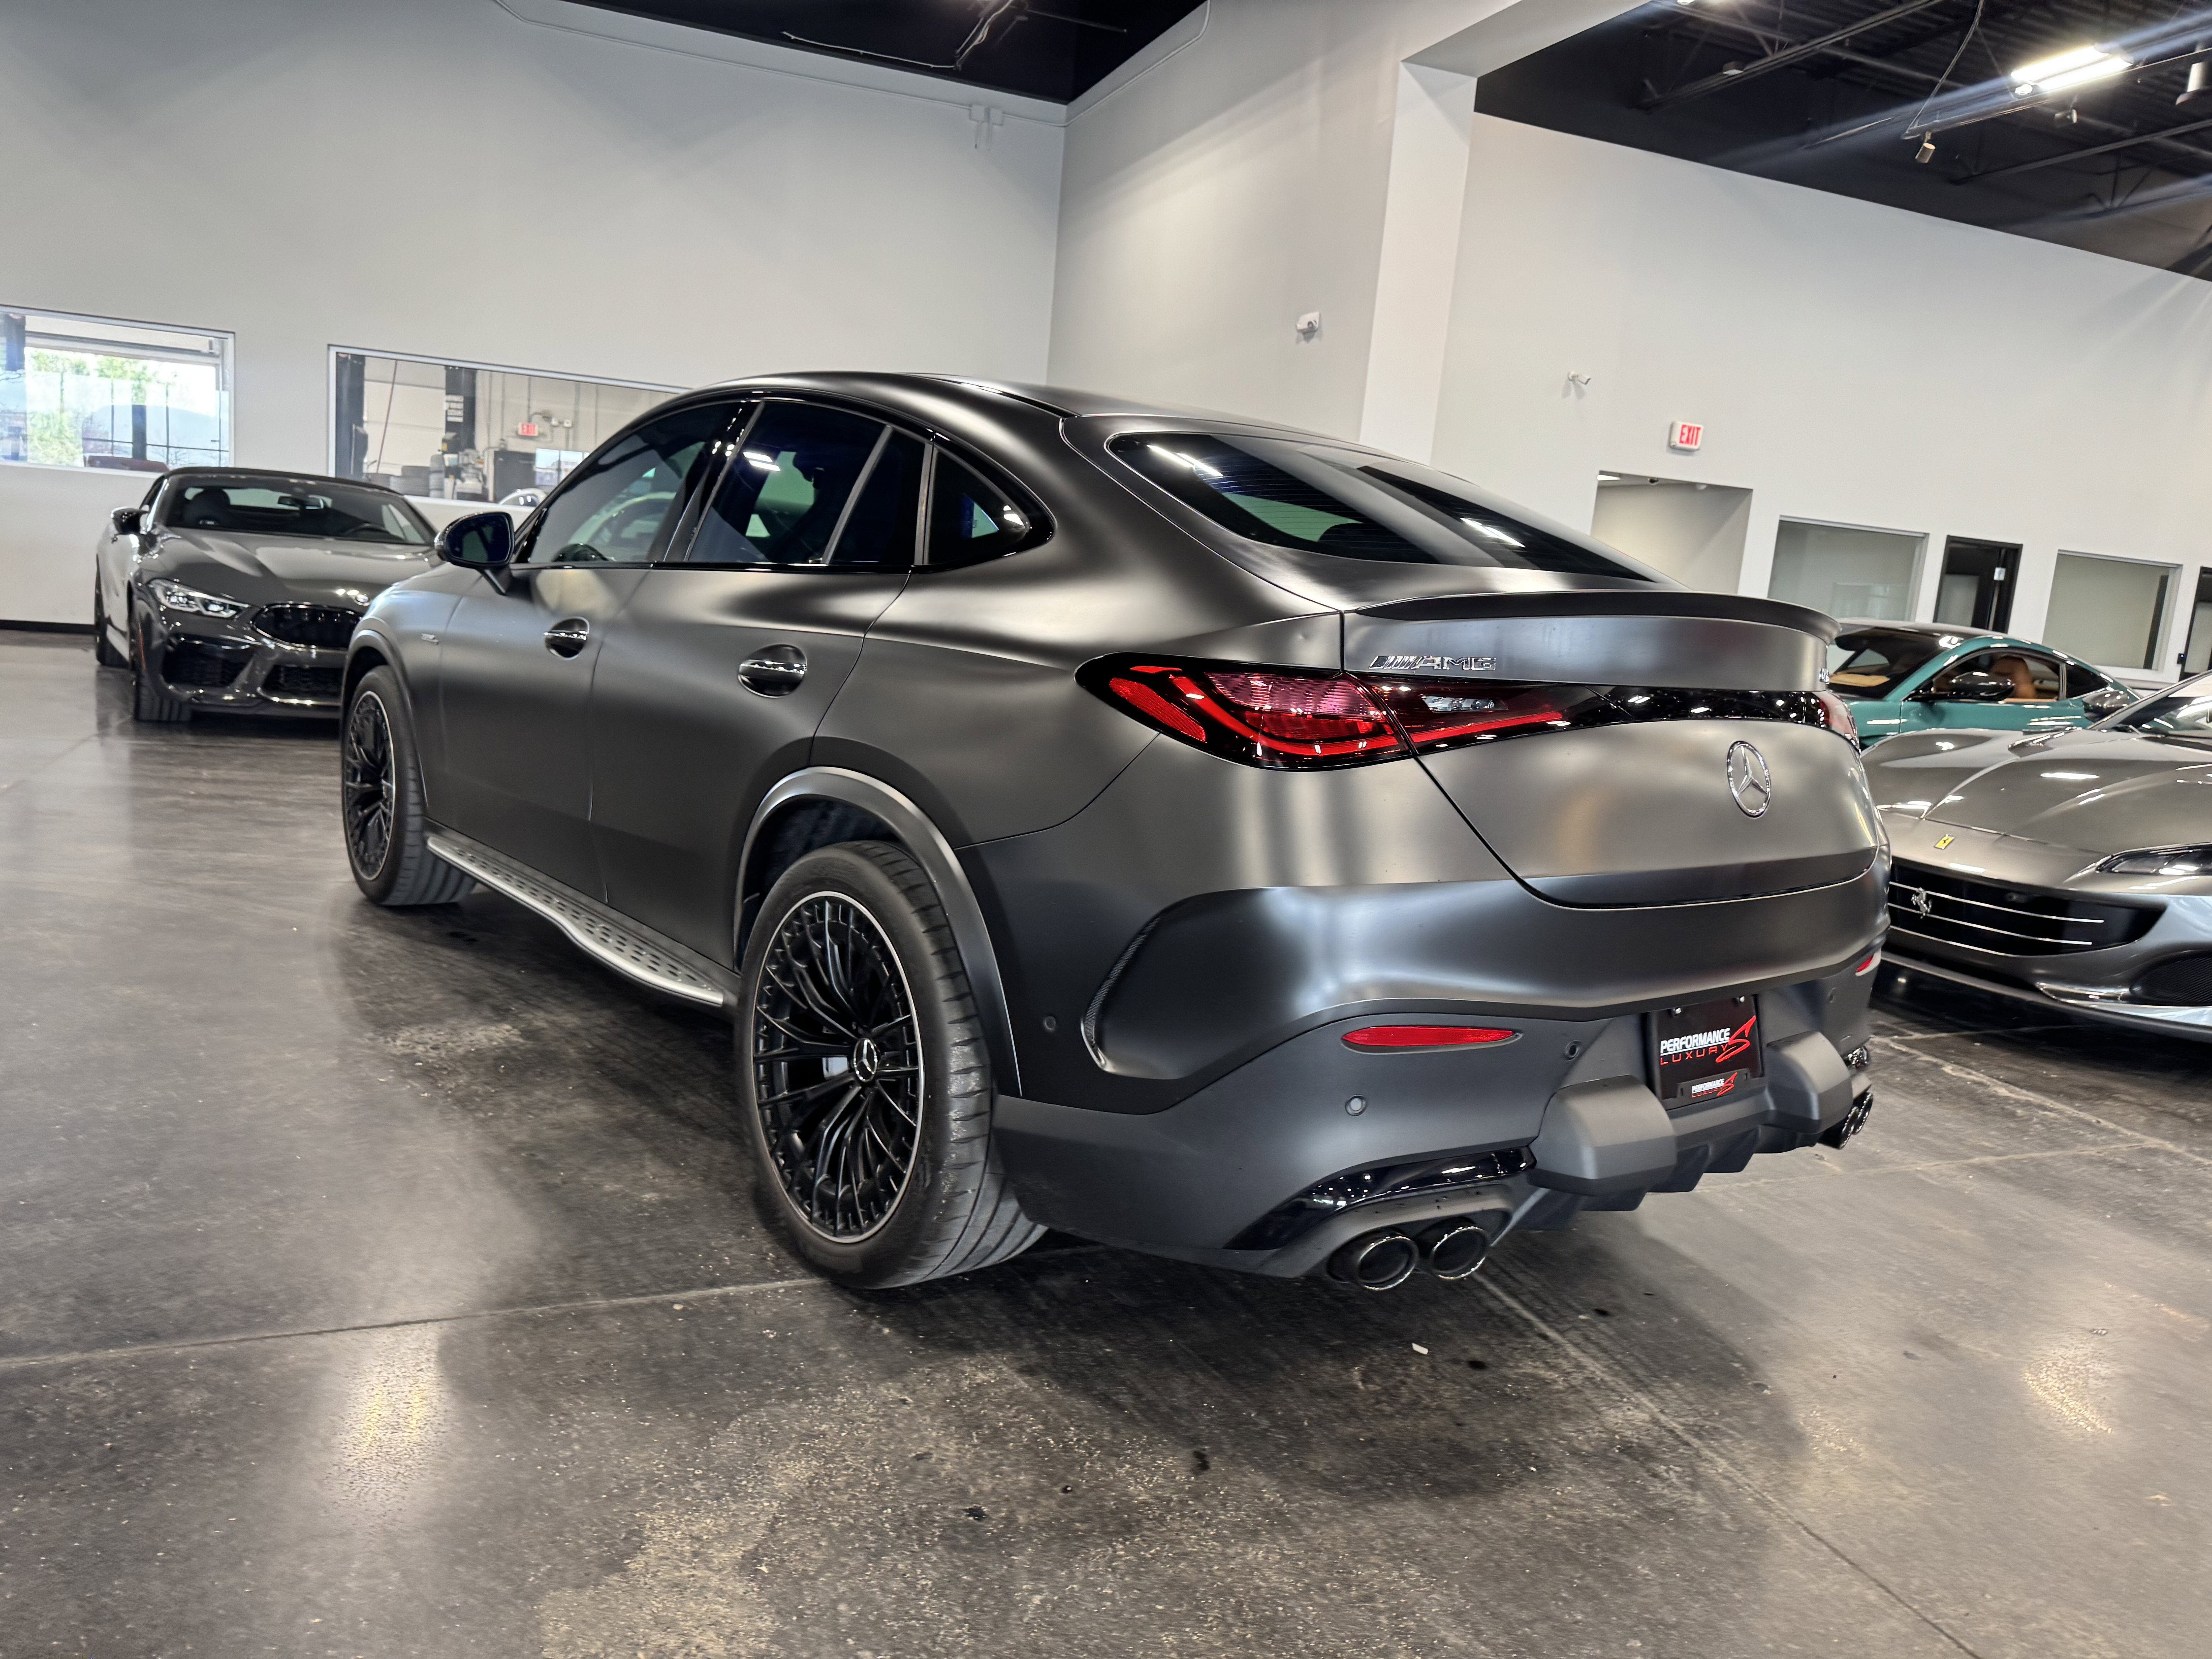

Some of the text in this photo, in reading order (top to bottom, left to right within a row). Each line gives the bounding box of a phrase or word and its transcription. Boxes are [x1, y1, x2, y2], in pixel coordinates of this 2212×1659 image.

[1679, 424, 1701, 446] EXIT
[1412, 656, 1496, 670] AMG
[1660, 1027, 1730, 1053] PERFORMANCE
[1660, 1043, 1728, 1065] LUXURY
